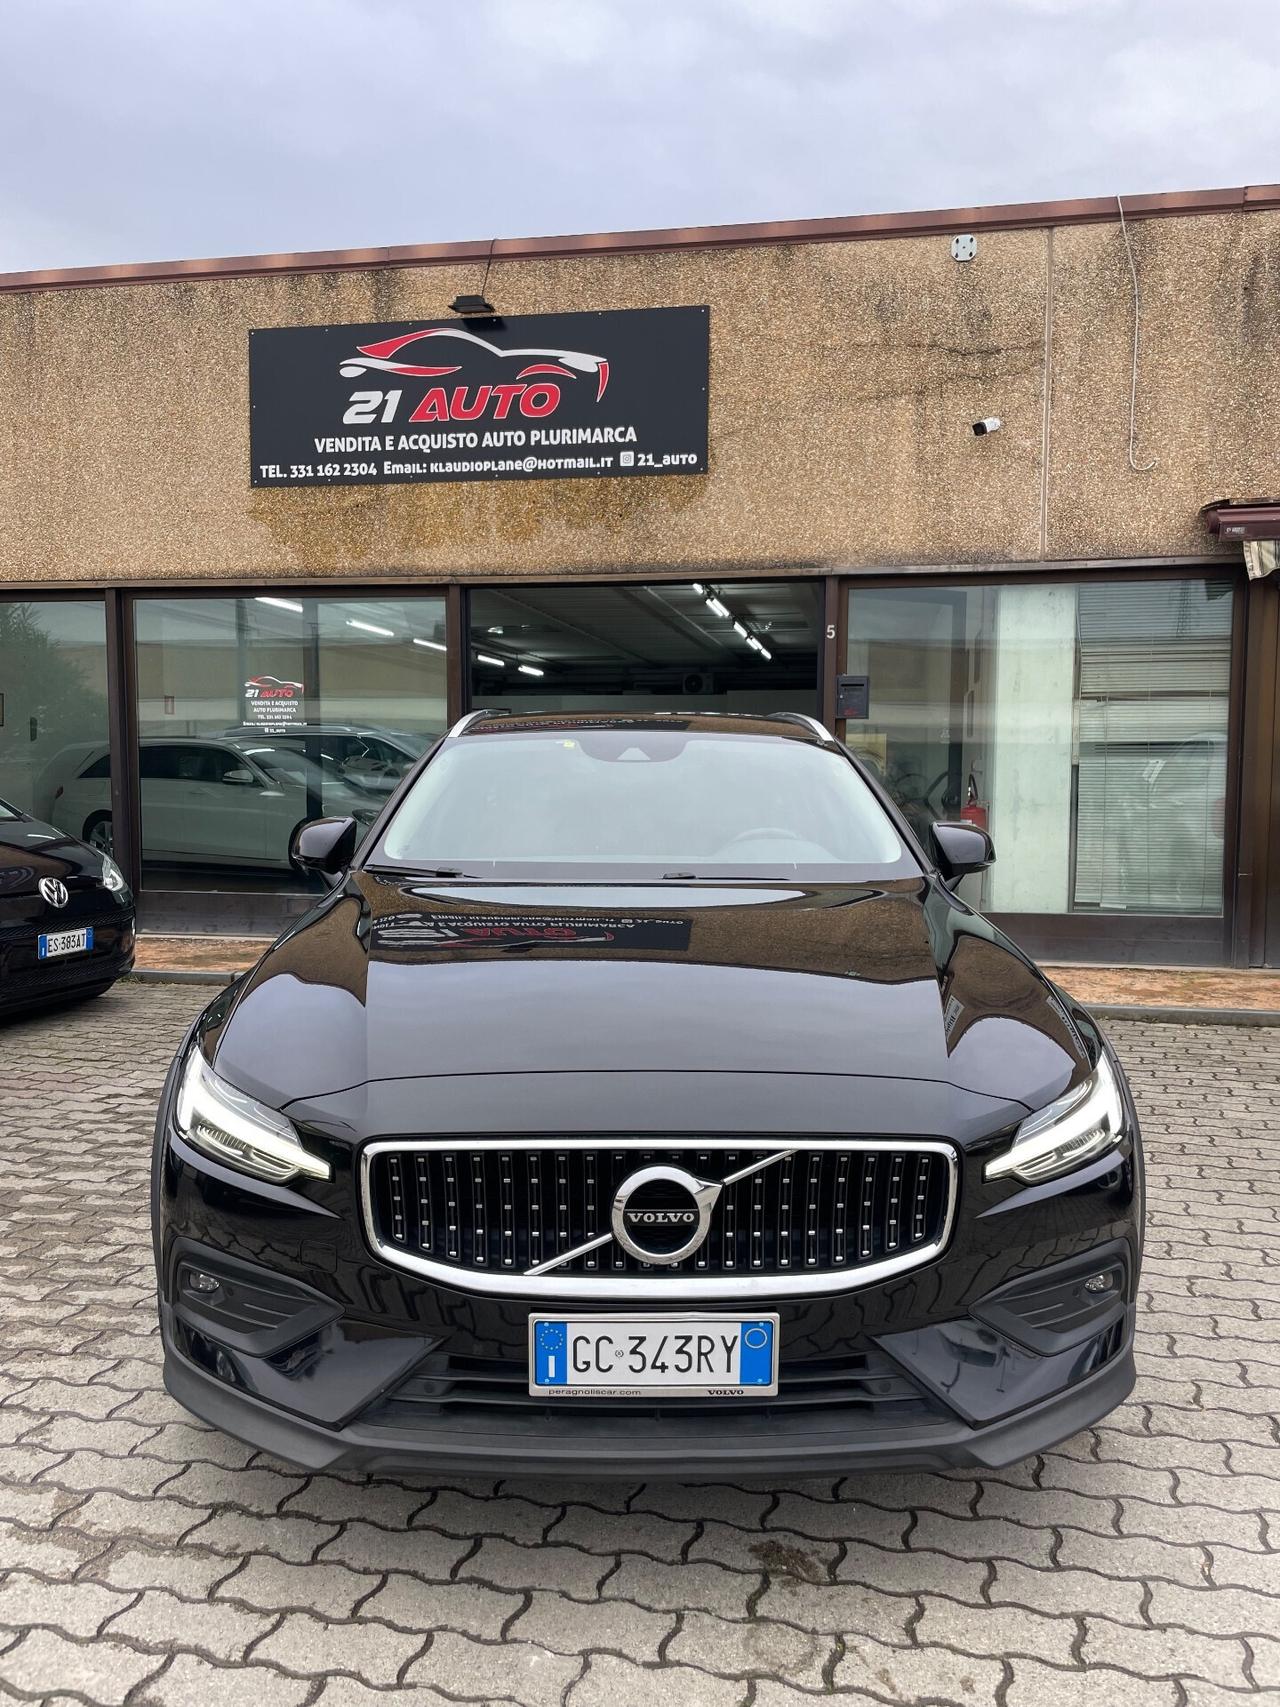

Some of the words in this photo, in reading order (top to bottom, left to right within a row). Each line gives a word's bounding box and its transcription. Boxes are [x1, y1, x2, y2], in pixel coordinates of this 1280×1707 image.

[343, 389, 403, 424] 21
[408, 382, 561, 423] AUTO
[314, 436, 381, 453] VENDITA
[385, 435, 395, 451] E
[397, 432, 478, 453] ACQUISTO
[481, 430, 526, 447] AUTO
[530, 426, 638, 446] PLURIMARCA
[259, 464, 287, 478] TEL.
[290, 464, 314, 478] 331
[316, 463, 341, 477] 162
[343, 462, 377, 477] 2304
[826, 624, 836, 639] 5
[245, 689, 259, 698] 21
[260, 688, 294, 698] AUTO
[627, 1212, 695, 1223] VOLVO
[548, 1388, 641, 1396] peragnoliscar.com
